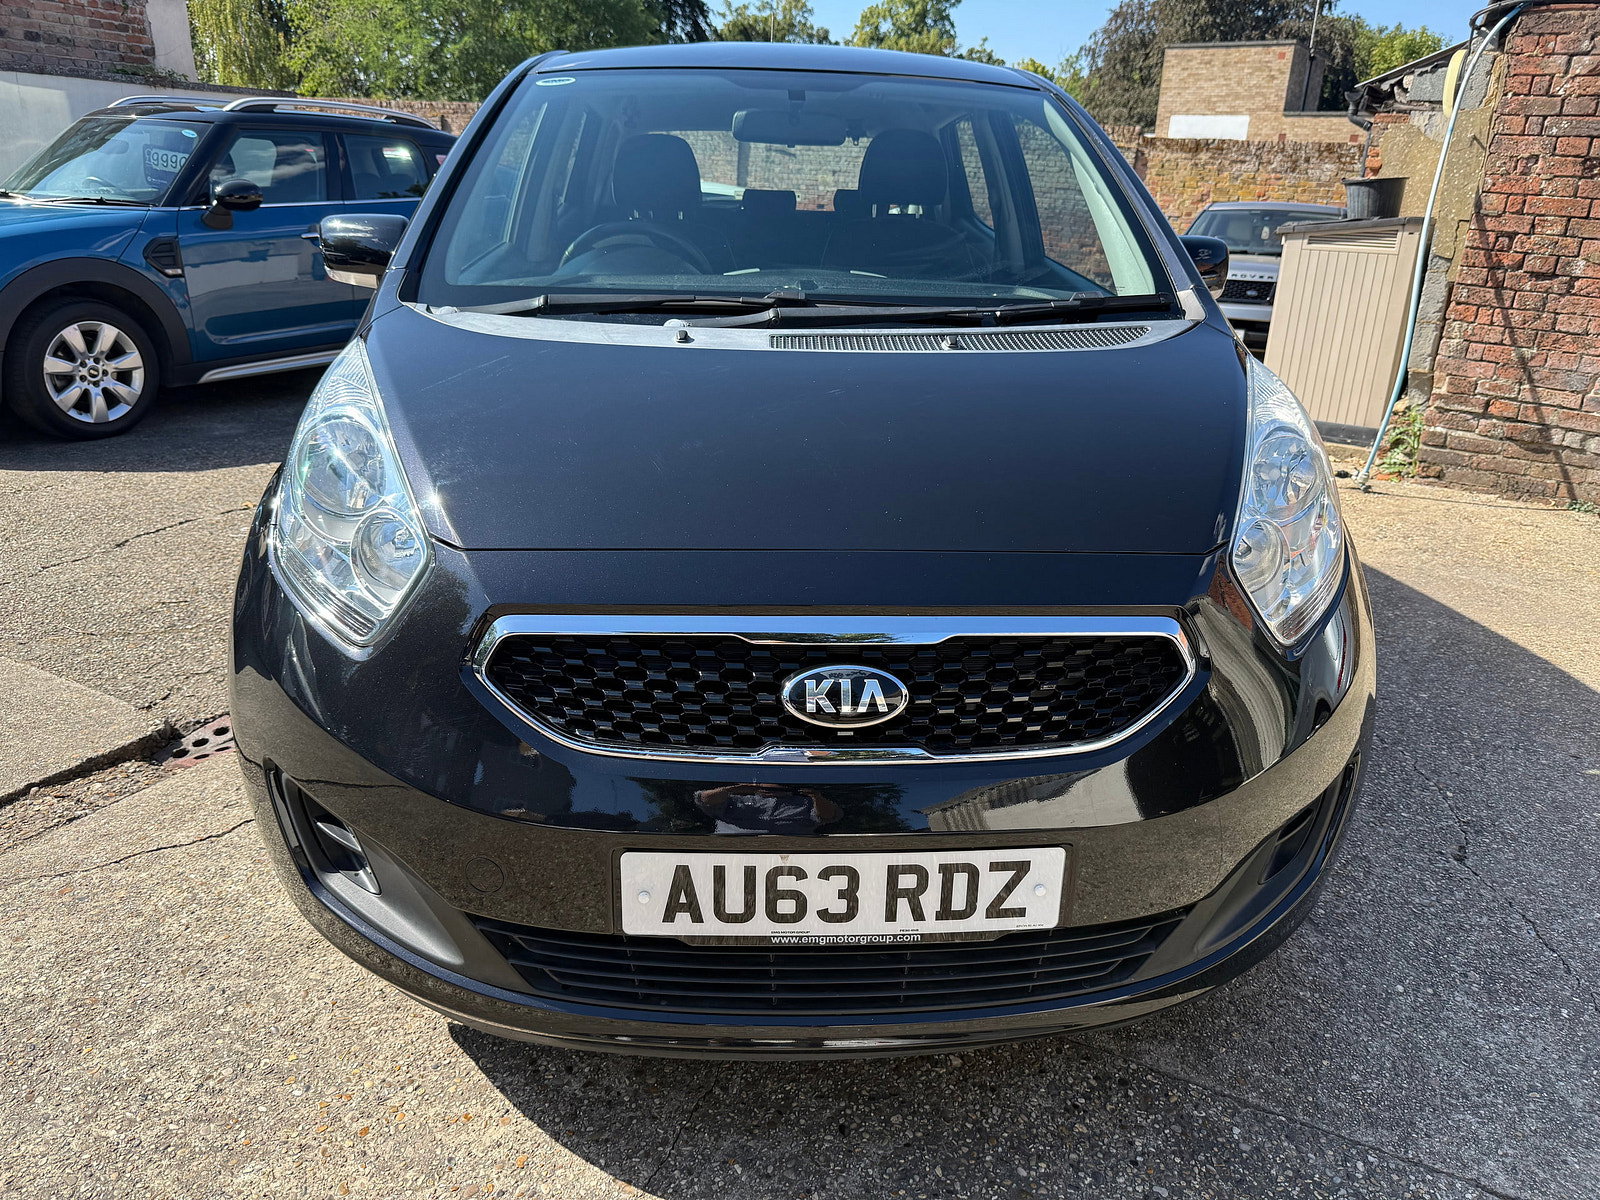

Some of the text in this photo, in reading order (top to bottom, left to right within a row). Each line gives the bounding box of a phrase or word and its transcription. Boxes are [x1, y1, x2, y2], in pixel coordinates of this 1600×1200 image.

[804, 679, 889, 713] KIA
[662, 860, 1032, 924] AU63 RDZ
[770, 934, 921, 945] www.emgmotorgroup.com
